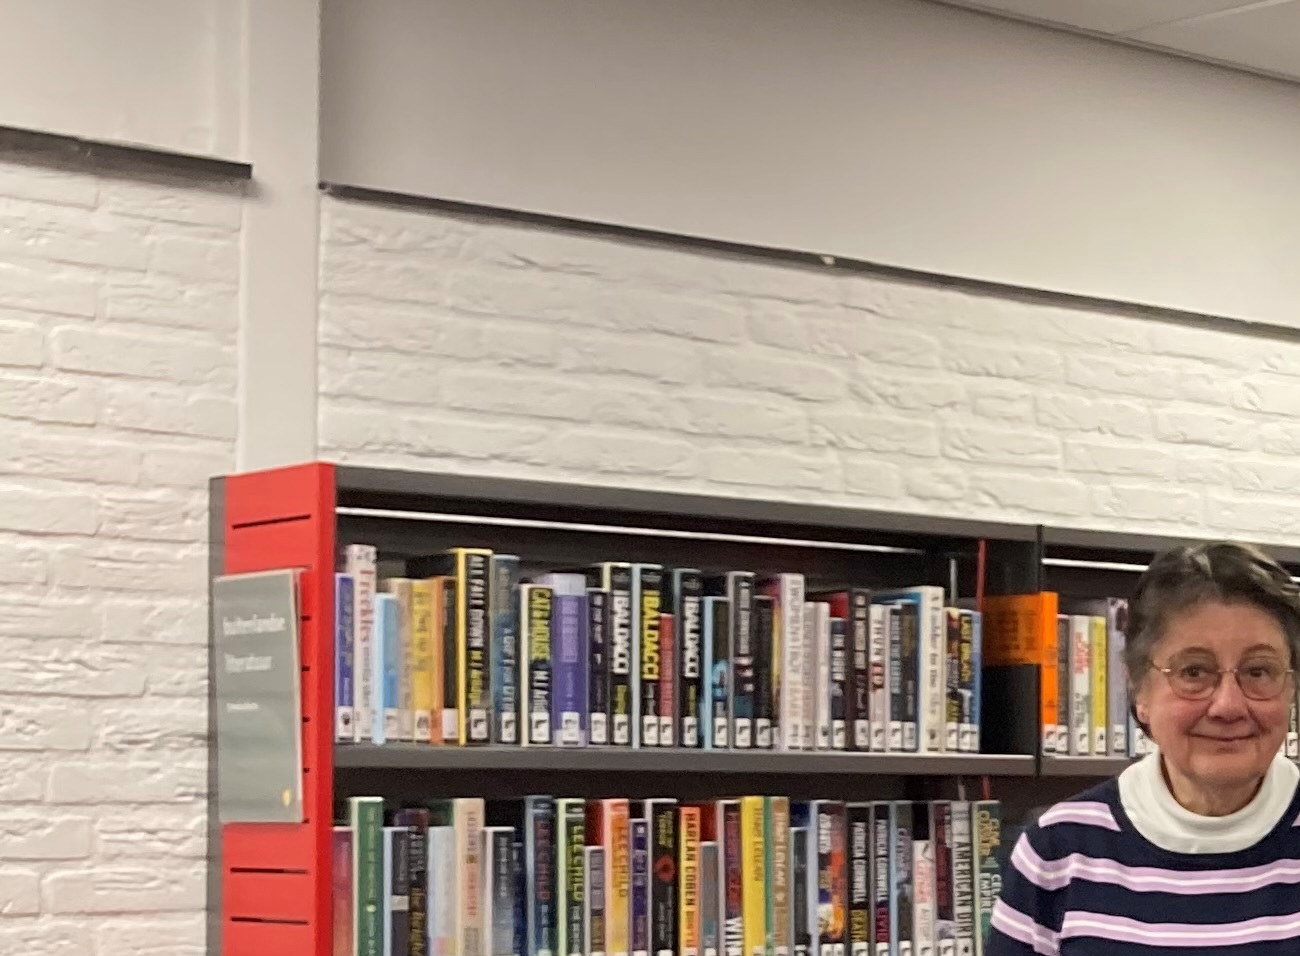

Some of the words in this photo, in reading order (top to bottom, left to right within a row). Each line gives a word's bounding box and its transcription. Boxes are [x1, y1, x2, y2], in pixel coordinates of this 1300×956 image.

[469, 556, 484, 575] ALL
[531, 589, 550, 610] CAT
[469, 608, 484, 648] DOWN
[531, 619, 550, 660] MOUSE
[613, 596, 629, 674] BALDACCI
[643, 596, 660, 680] BALDACCI
[684, 601, 699, 678] BALDACCI
[573, 826, 584, 854] LEE
[685, 813, 698, 862] HARLAN
[852, 822, 867, 858] PATRICIA
[876, 819, 889, 856] PATRICIA
[573, 856, 584, 902] CHILD
[685, 866, 698, 906] COBEN
[852, 859, 867, 904] CORNWELL
[876, 857, 889, 902] CORNWELL
[955, 841, 973, 907] AMERICAN
[980, 872, 992, 914] EMPIRE
[956, 911, 975, 939] DIRT
